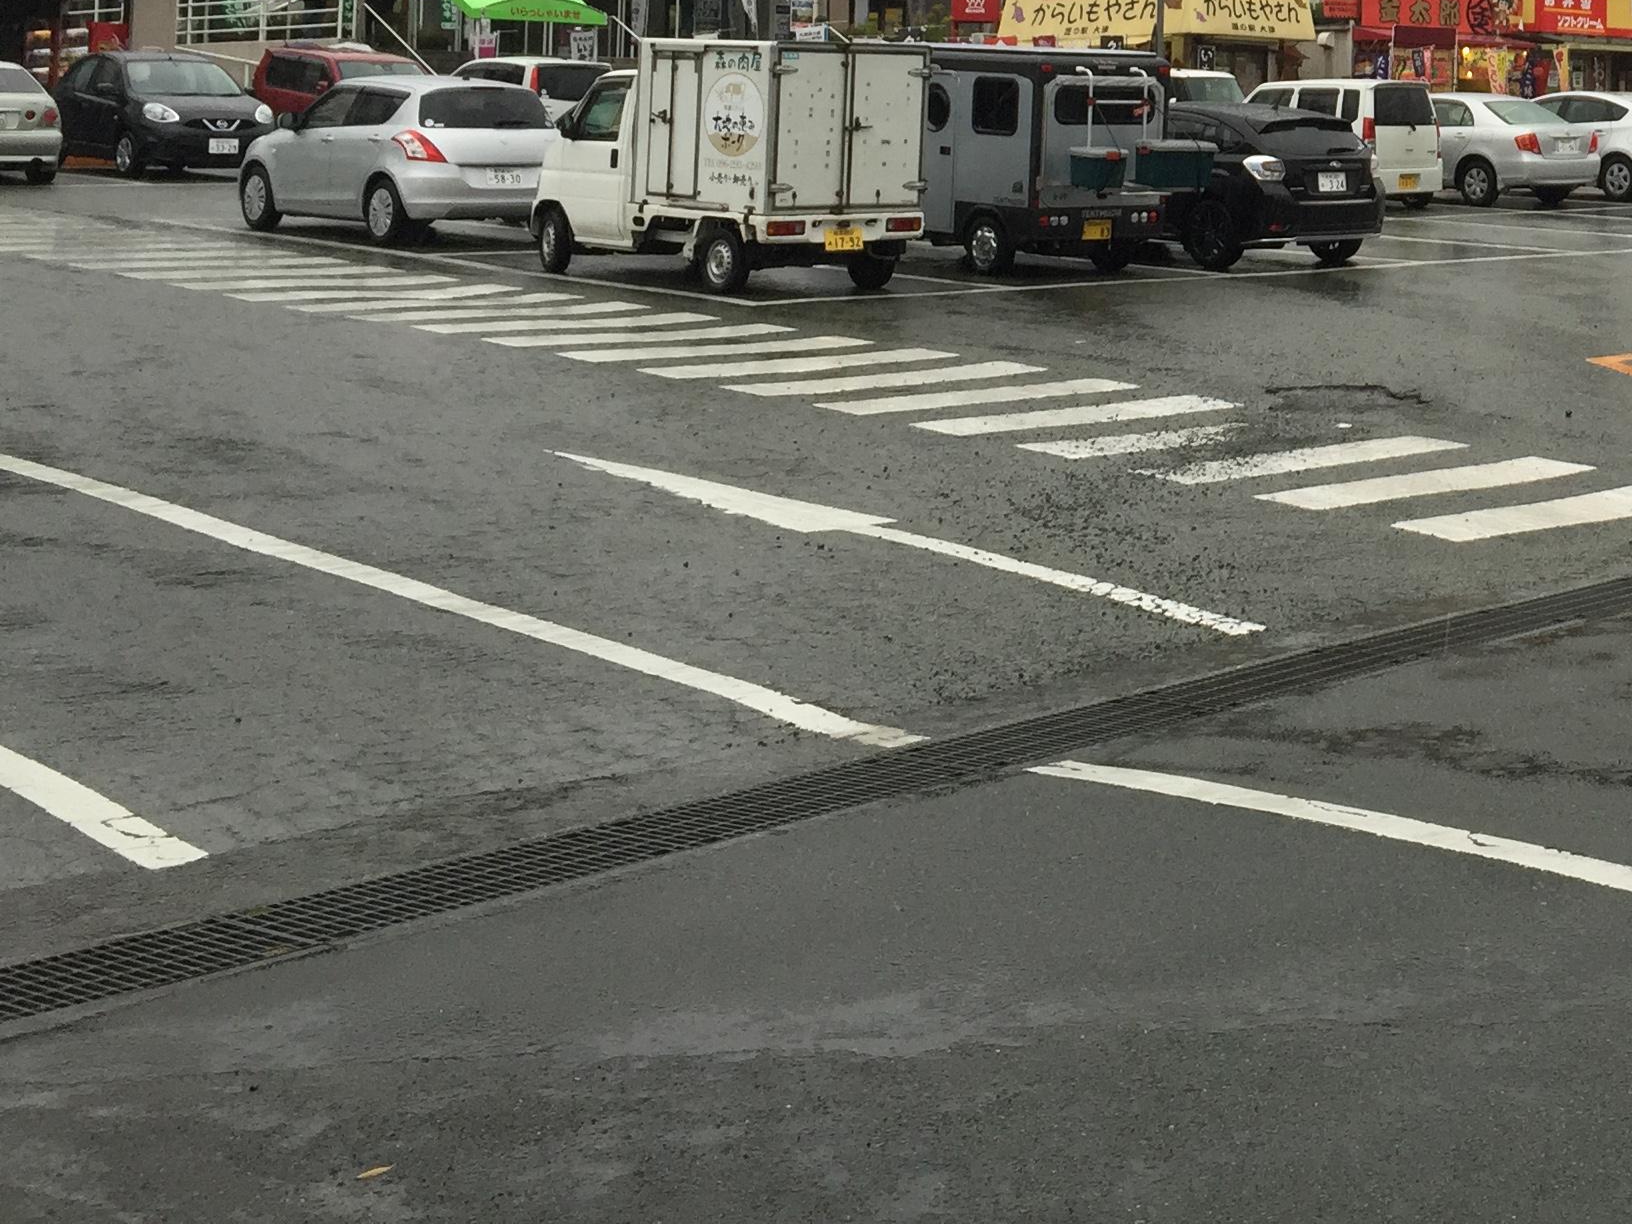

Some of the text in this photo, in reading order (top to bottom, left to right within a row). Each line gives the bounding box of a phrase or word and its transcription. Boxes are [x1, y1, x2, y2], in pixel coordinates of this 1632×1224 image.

[1557, 15, 1605, 30] ソフトクリーム
